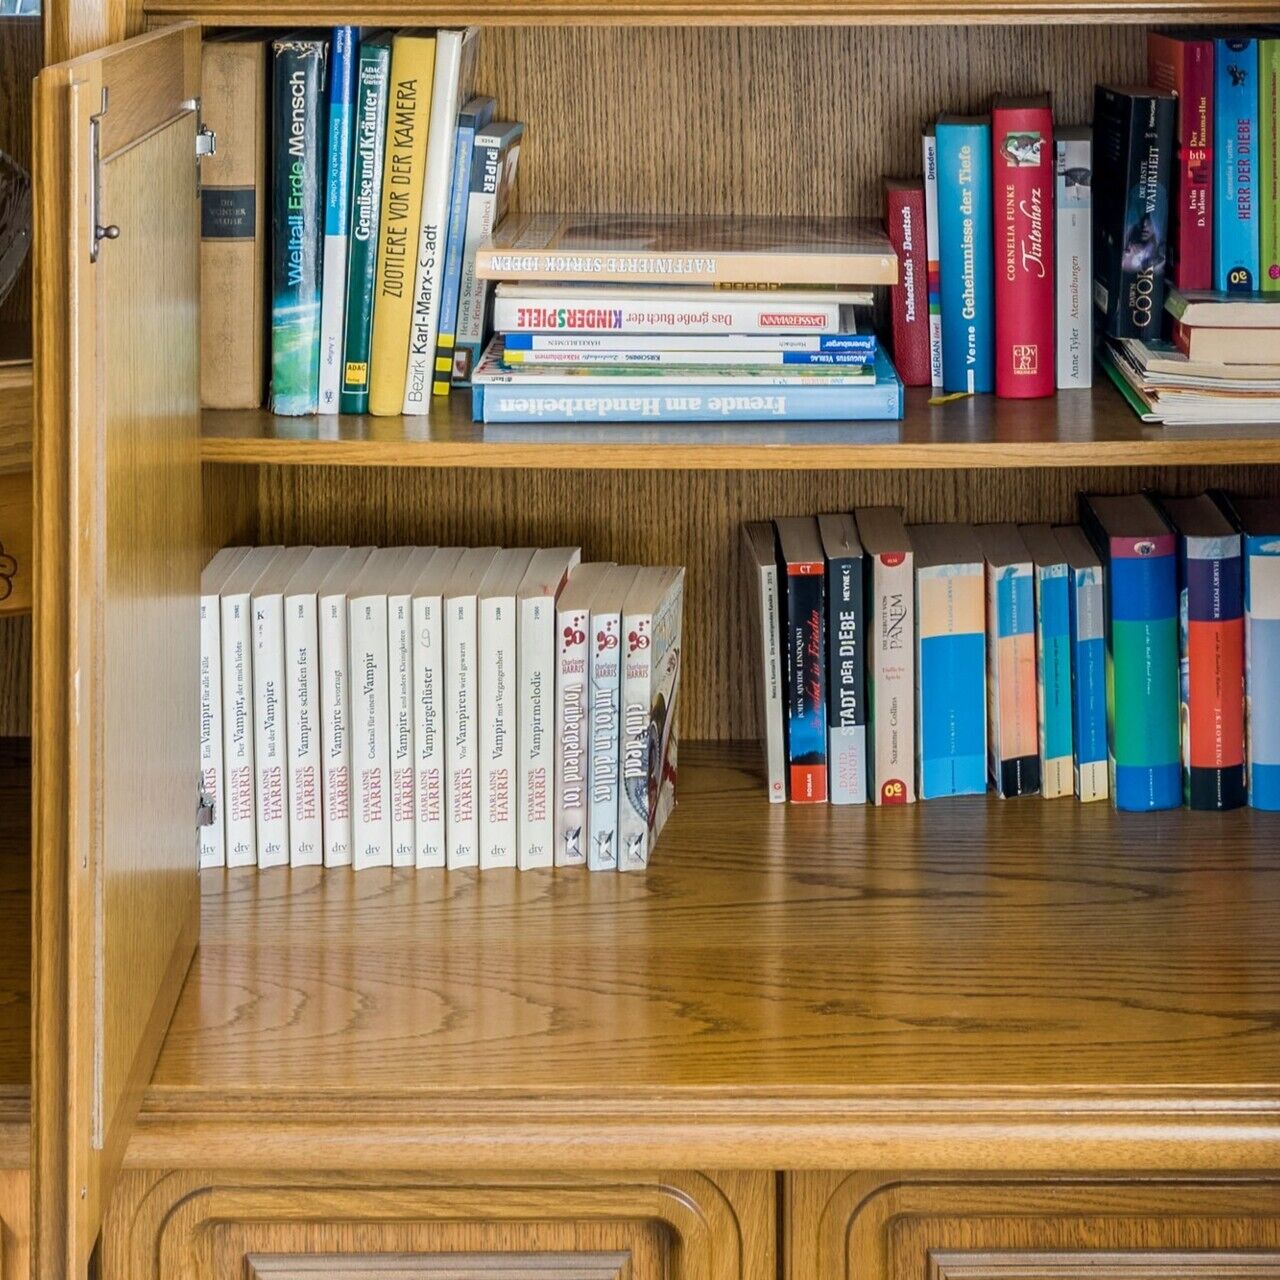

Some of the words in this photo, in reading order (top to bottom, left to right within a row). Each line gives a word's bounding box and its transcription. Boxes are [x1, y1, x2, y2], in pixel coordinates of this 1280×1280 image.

[289, 71, 306, 156] Mensch
[363, 90, 378, 148] Kräuter
[394, 79, 418, 148] KAMERA
[1237, 118, 1251, 154] DIEBE
[363, 149, 375, 177] und
[391, 156, 412, 186] DER
[483, 148, 498, 194] PIPER
[959, 145, 971, 185] Tiefe
[1145, 145, 1159, 214] WAHRHEIT
[1237, 157, 1251, 182] DER
[289, 162, 305, 209] Erde
[961, 188, 973, 215] der
[1007, 184, 1015, 221] FUNKE
[1237, 185, 1251, 221] HERR
[355, 178, 374, 241] Gemüse
[389, 191, 409, 221] VOR
[901, 206, 912, 251] Deutsch
[1020, 188, 1045, 279] Tintenherz
[288, 215, 305, 287] Weltall
[383, 226, 407, 299] ZOOTIERE
[489, 256, 539, 271] IDEEN
[545, 257, 601, 272] STRICK
[606, 258, 717, 273] RAFFINIERTE
[962, 219, 975, 320] Geheimnisse
[1007, 224, 1015, 281] CORNELIA
[906, 258, 915, 322] Tschechisch
[1133, 265, 1153, 327] COOK
[517, 308, 622, 329] KINDERSPIELE
[626, 312, 642, 324] der
[645, 312, 673, 326] Buch
[676, 313, 710, 327] große
[712, 313, 733, 326] Das
[966, 326, 976, 364] Verne
[1071, 327, 1080, 354] Tyler
[408, 354, 425, 404] Bezirk
[1071, 356, 1079, 379] Anne
[497, 396, 659, 414] Handarbeiten
[665, 396, 700, 414] am
[709, 396, 786, 414] Freude
[839, 611, 855, 657] DIEBE
[297, 647, 307, 666] fest
[840, 660, 854, 684] DER
[297, 668, 307, 708] schlafen
[422, 667, 436, 759] Vampirgeflüster
[530, 671, 543, 759] Vampirmelodie
[840, 689, 856, 736] STADT
[298, 711, 311, 758] Vampire
[562, 684, 583, 782] Vorübergehend
[594, 737, 612, 751] in
[271, 766, 282, 821] HARRIS
[428, 768, 439, 821] HARRIS
[535, 767, 546, 821] HARRIS
[564, 786, 582, 810] tot
[593, 754, 615, 803] dallas
